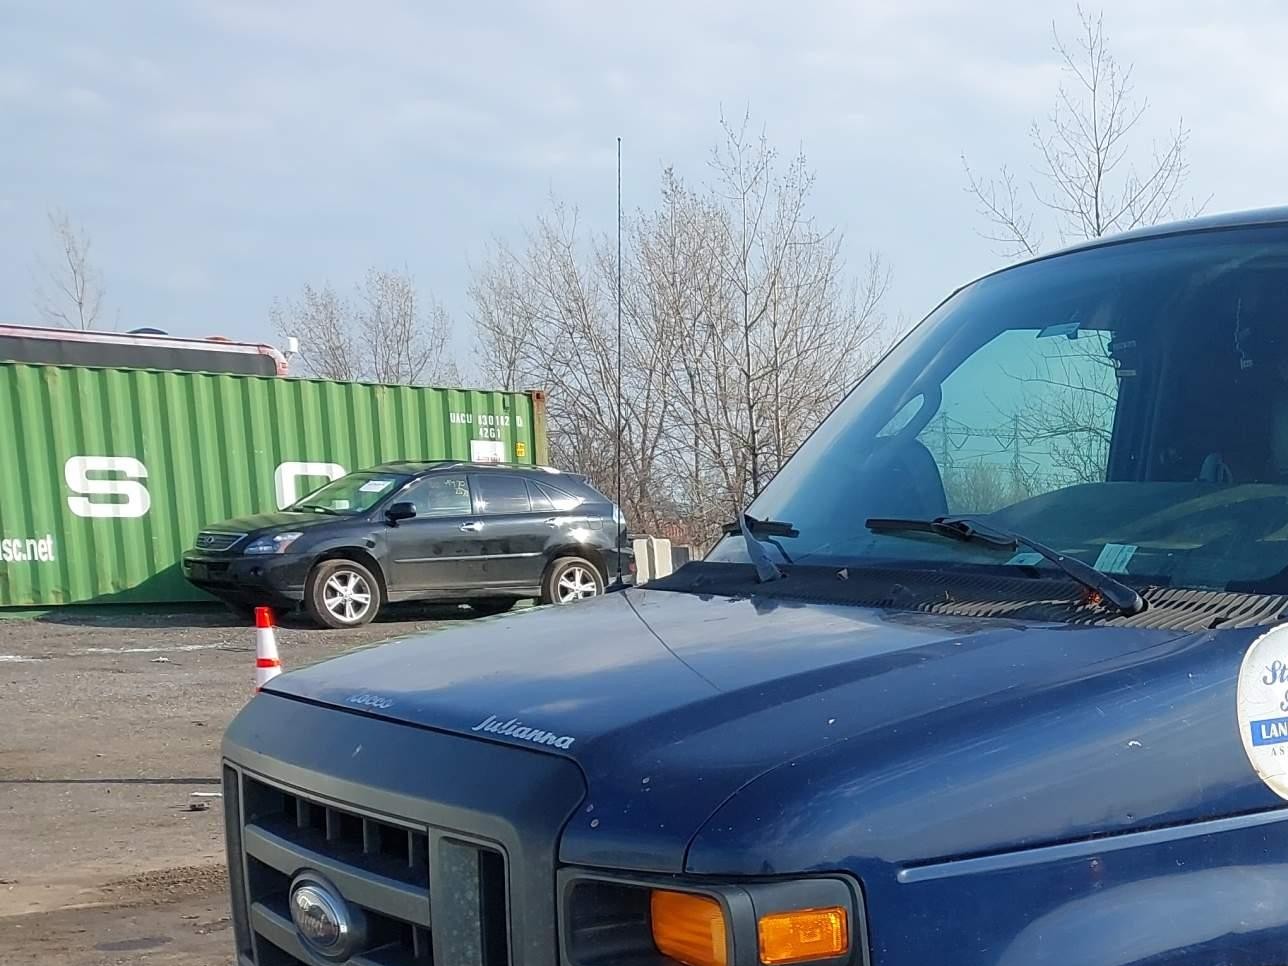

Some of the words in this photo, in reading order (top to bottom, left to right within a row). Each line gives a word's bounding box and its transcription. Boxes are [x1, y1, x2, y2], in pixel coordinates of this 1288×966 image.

[450, 412, 472, 424] UACU
[0, 533, 54, 562] sc.net
[471, 715, 576, 750] Julianna
